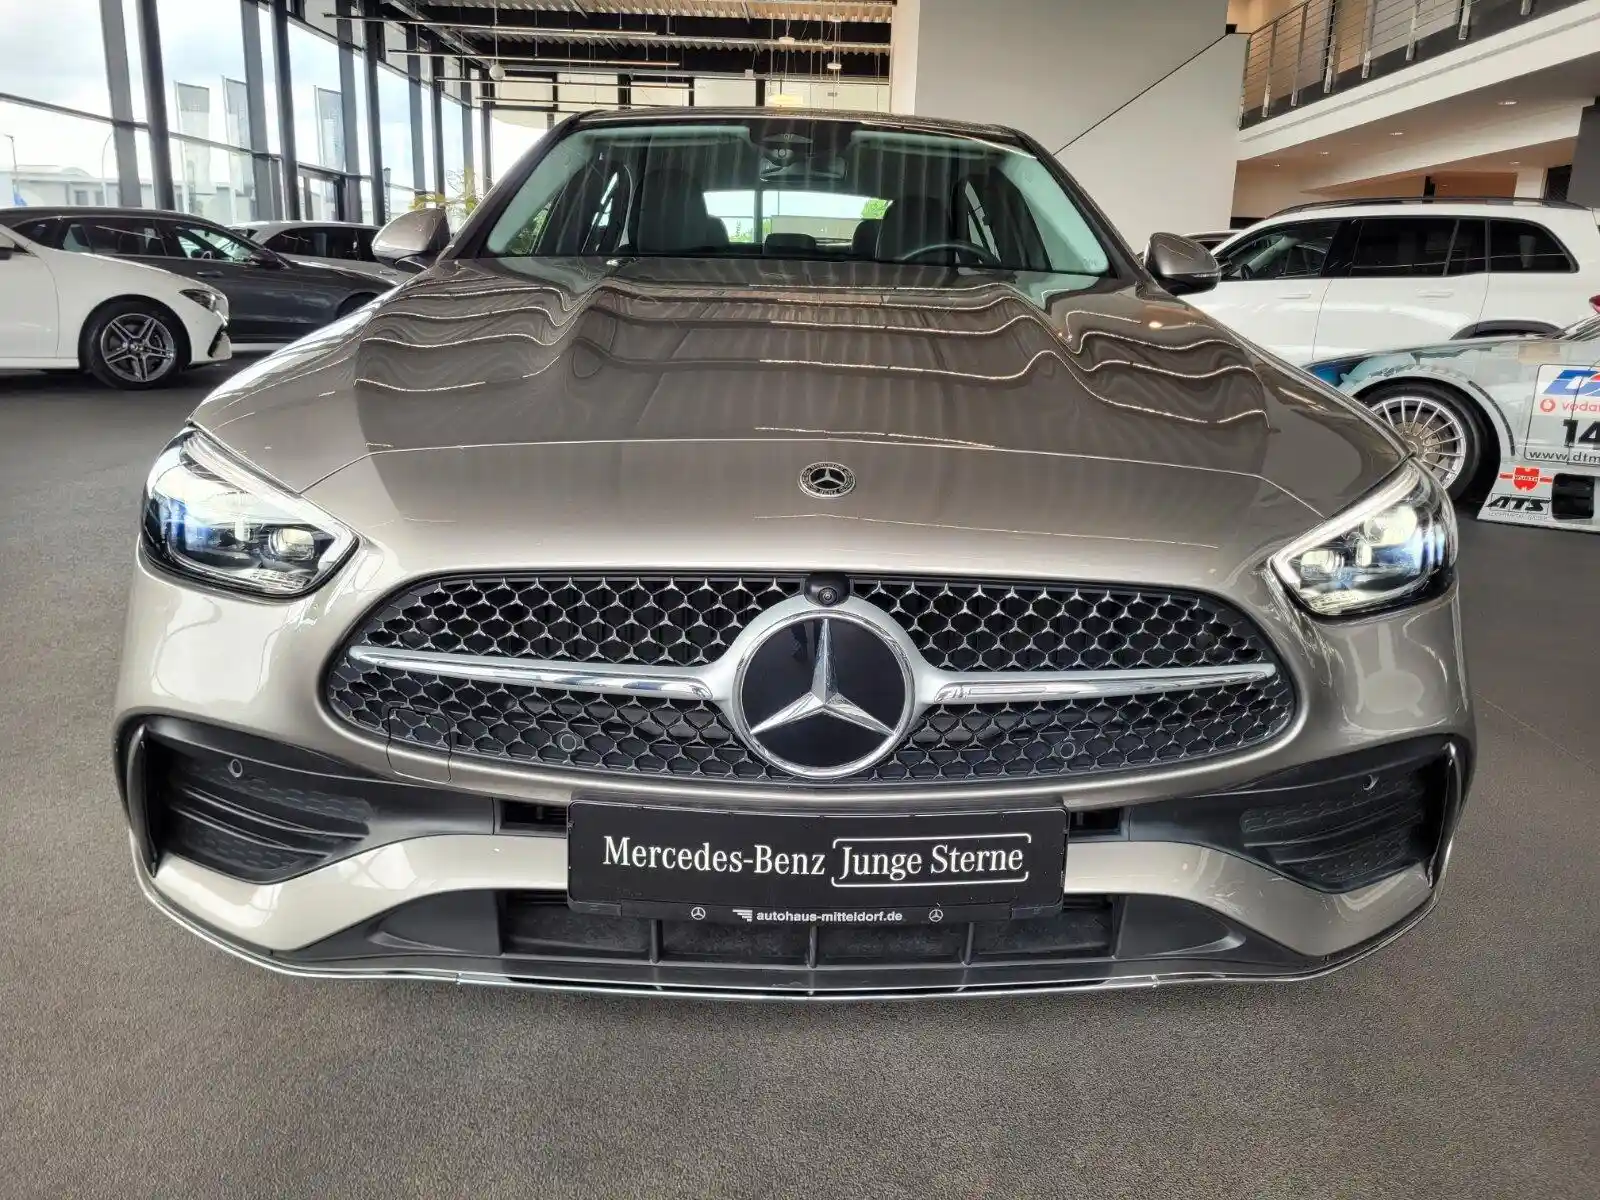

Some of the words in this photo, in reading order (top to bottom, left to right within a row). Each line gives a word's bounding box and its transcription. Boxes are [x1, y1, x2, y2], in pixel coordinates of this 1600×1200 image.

[1562, 401, 1600, 412] voda
[1485, 496, 1552, 511] ATS
[602, 836, 826, 875] Mercedes-Benz
[839, 846, 922, 881] Junge
[930, 844, 1023, 874] Sterne
[756, 911, 903, 922] autohaus-mitteldorf.de
